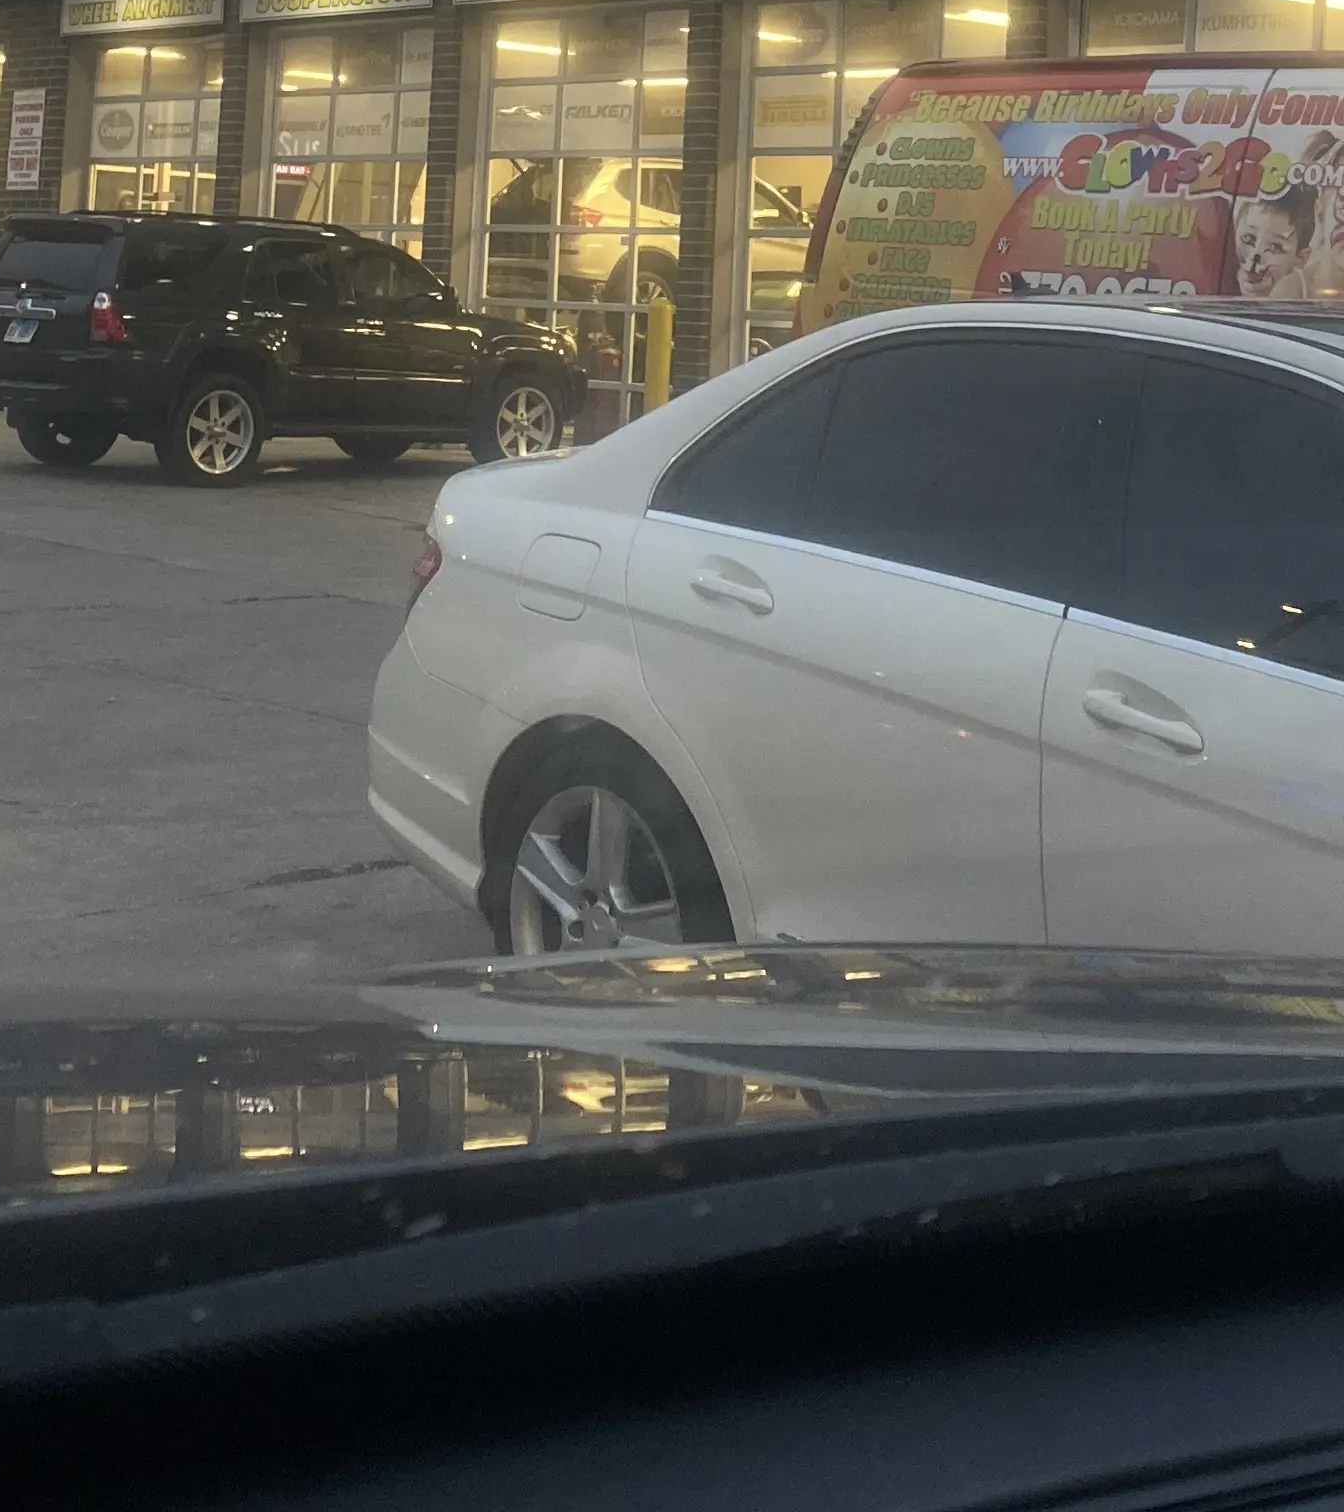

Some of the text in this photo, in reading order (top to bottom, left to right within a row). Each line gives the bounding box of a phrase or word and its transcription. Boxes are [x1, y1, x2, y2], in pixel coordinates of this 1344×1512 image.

[68, 0, 118, 27] WHEEL
[1032, 87, 1179, 125] Birthdays
[1181, 87, 1258, 128] Only
[1030, 194, 1198, 238] Book A Party
[1061, 231, 1154, 273] Today!
